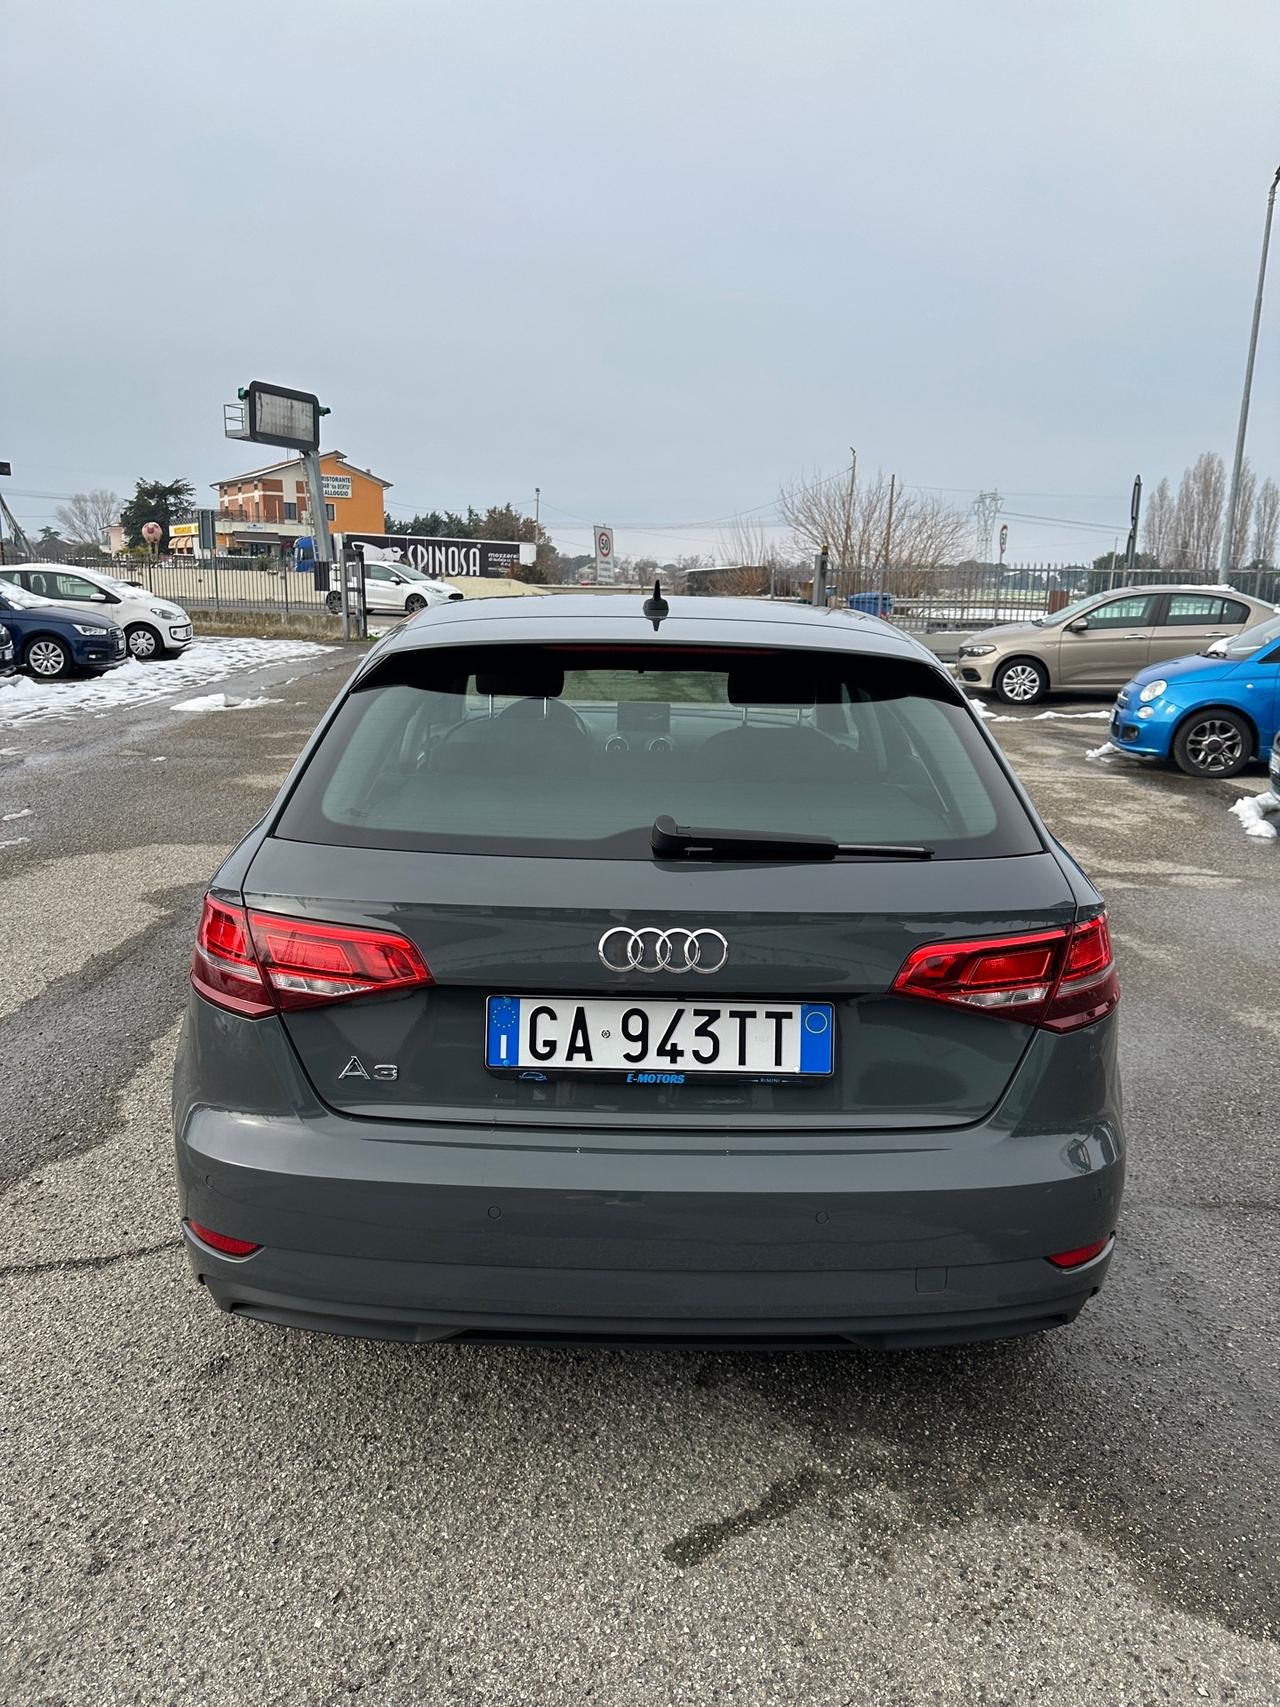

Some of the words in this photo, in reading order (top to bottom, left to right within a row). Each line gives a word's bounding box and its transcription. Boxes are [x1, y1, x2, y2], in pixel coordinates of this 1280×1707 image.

[601, 538, 608, 550] 50
[408, 544, 480, 576] SPINOSA
[529, 1006, 593, 1062] GA
[621, 1007, 793, 1066] 943TT
[338, 1055, 398, 1080] A3
[626, 1073, 685, 1084] E-MOTORS
